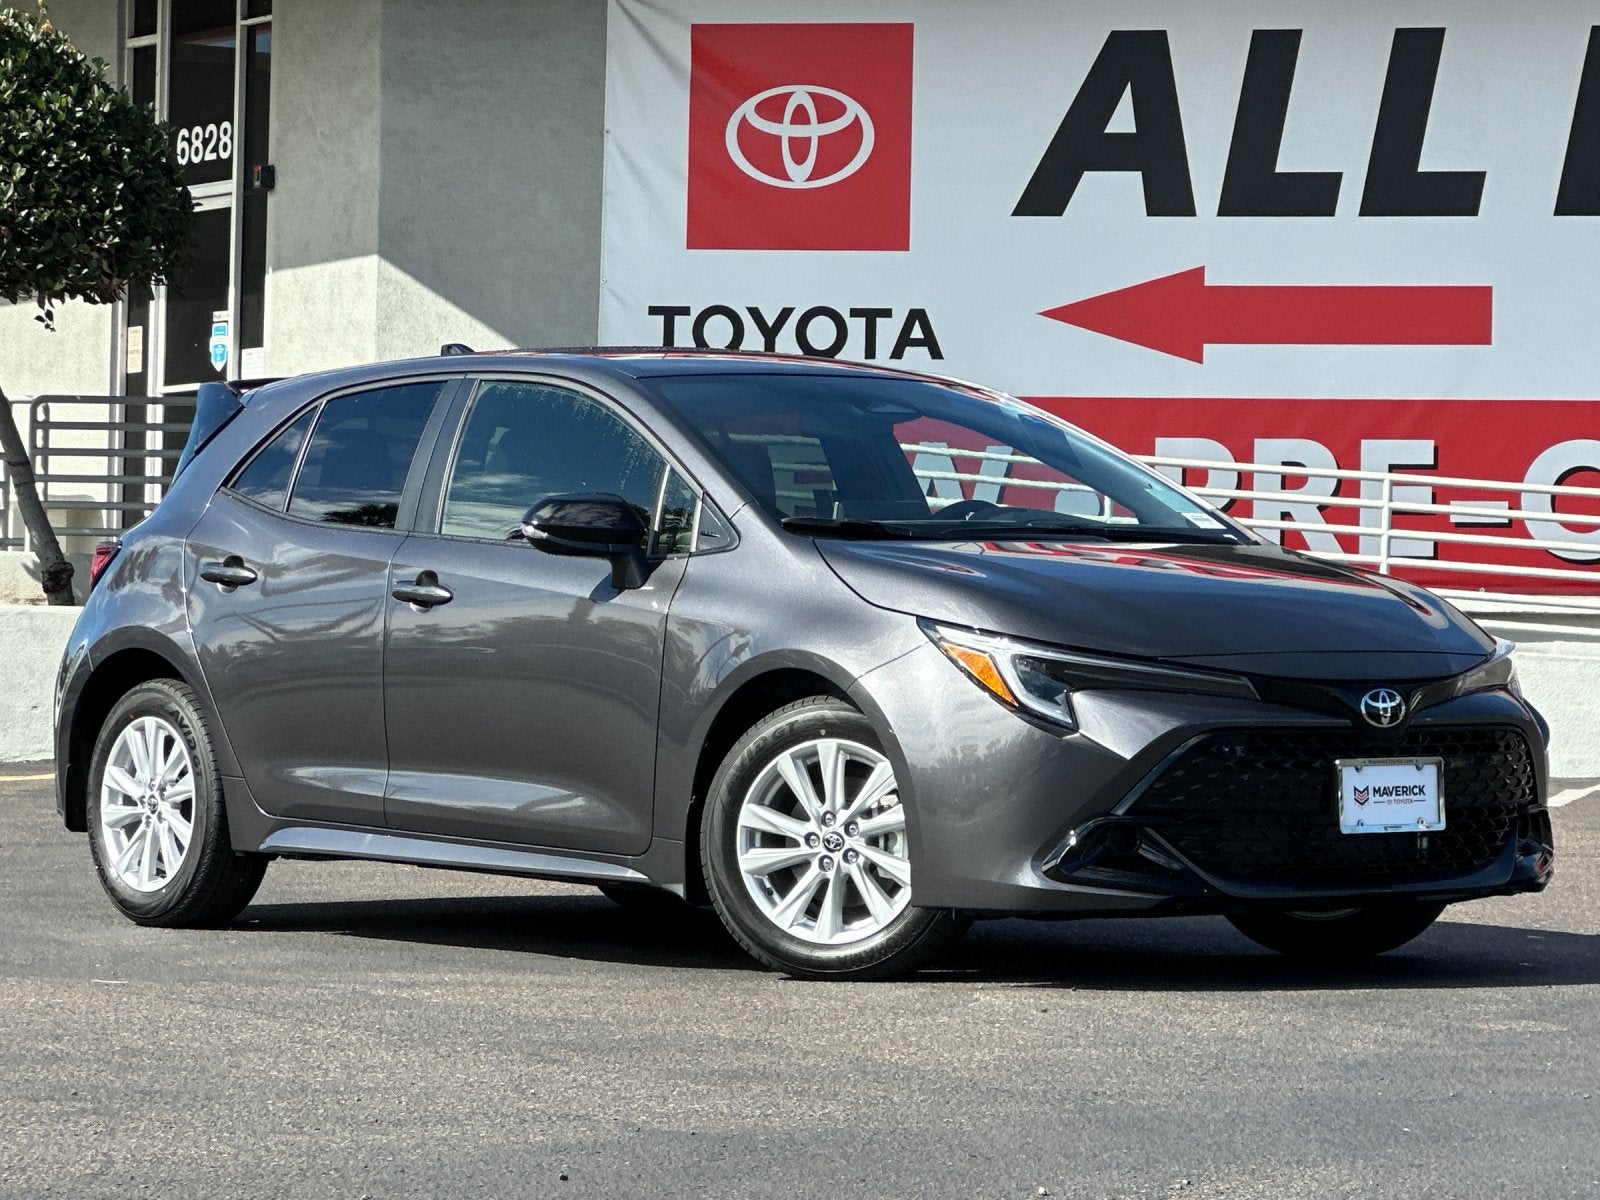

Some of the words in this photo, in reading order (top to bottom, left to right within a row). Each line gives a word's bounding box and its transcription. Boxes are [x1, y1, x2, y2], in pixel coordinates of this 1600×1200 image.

[177, 121, 232, 165] 6828
[1010, 27, 1487, 217] ALL
[648, 305, 944, 360] TOYOTA
[1373, 785, 1426, 797] MAVERICK
